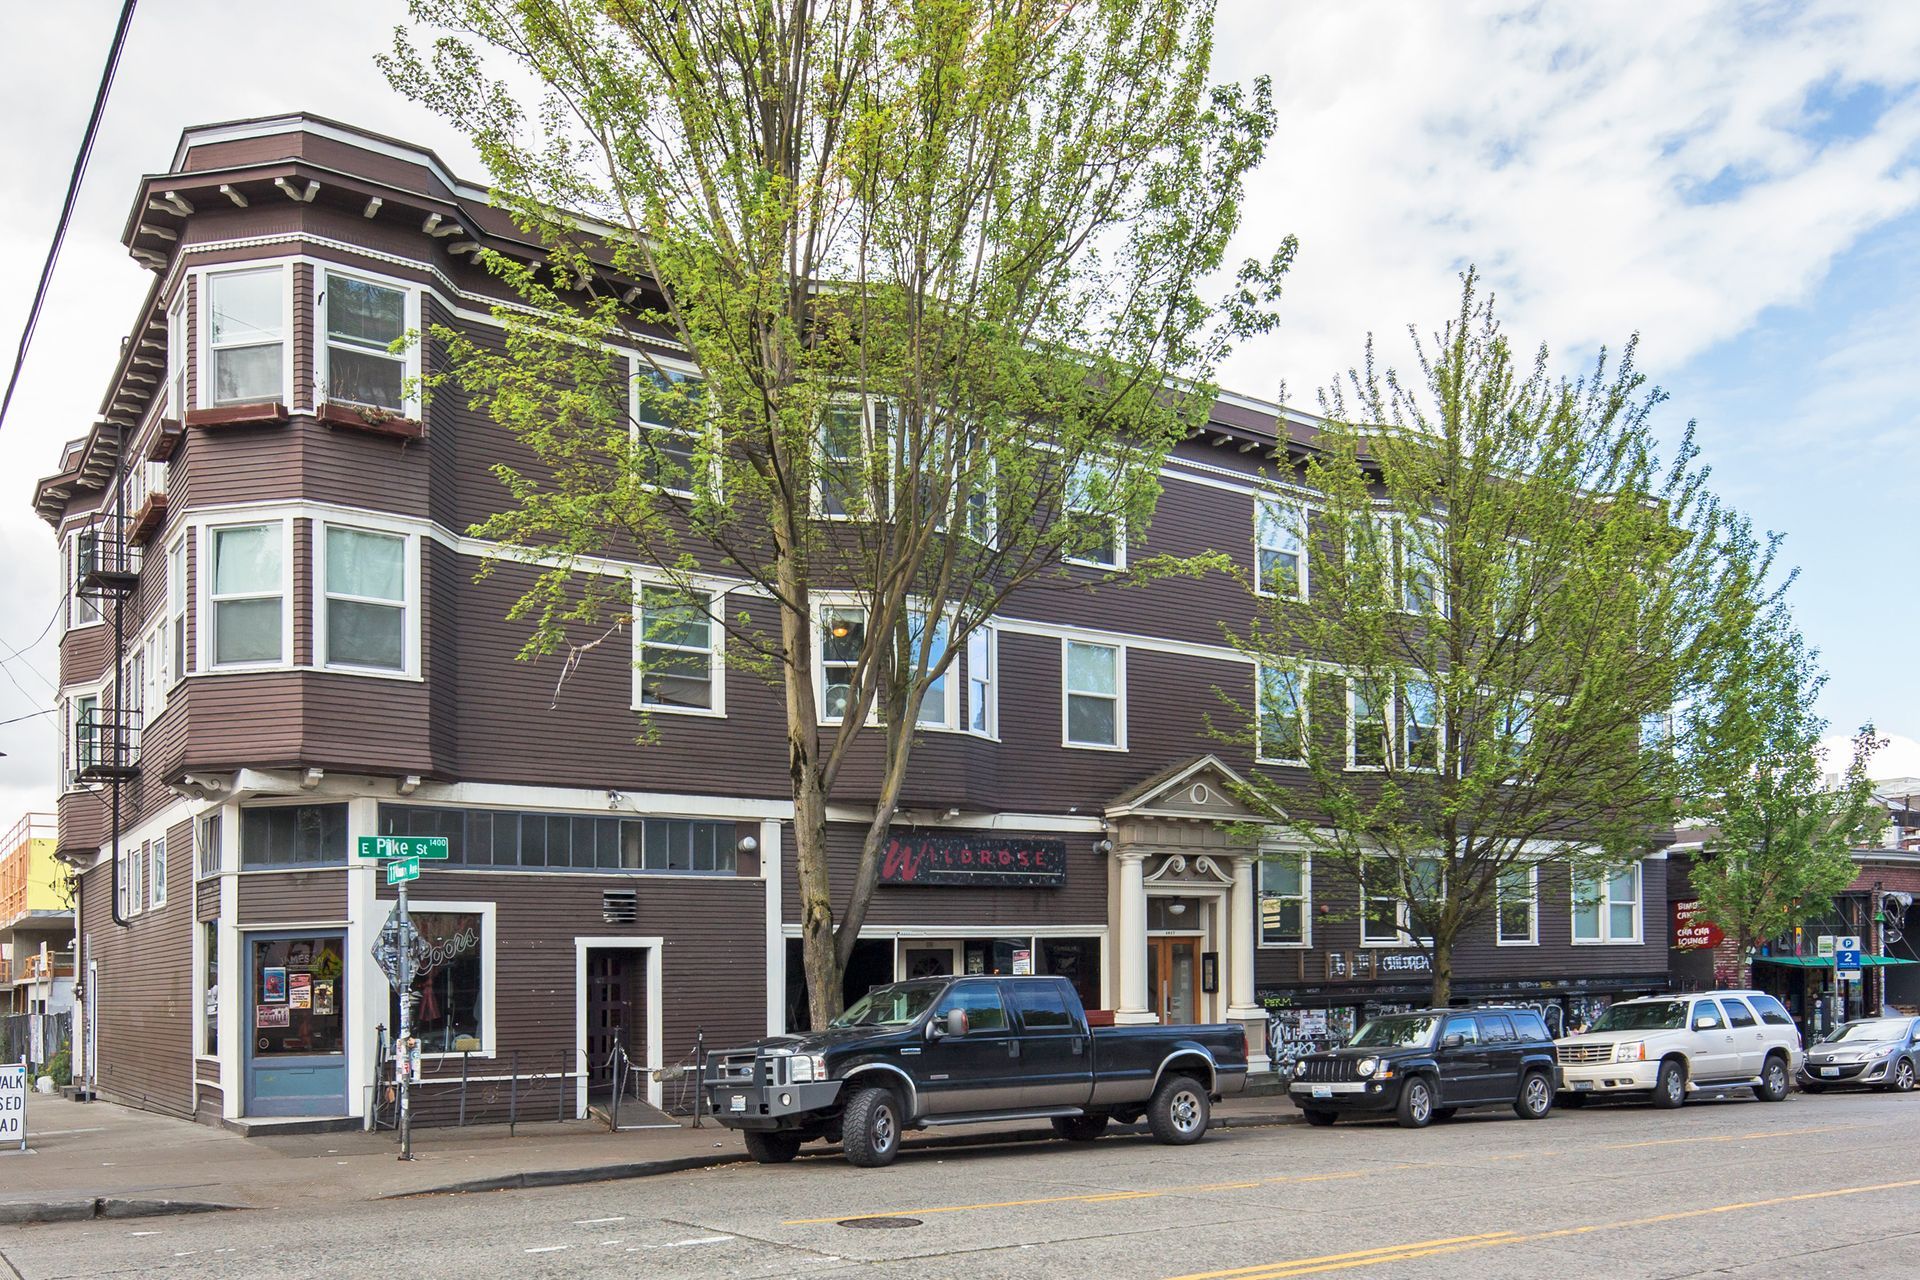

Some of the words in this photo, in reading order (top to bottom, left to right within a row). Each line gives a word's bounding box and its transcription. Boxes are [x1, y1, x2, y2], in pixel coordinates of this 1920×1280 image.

[362, 843, 370, 854] E
[377, 838, 409, 856] Pike
[416, 843, 428, 855] St
[429, 839, 446, 847] 1400
[882, 839, 1047, 881] WILDROSE
[1677, 929, 1693, 937] CHA
[1694, 927, 1710, 936] CHA
[1678, 936, 1709, 946] LOUNGE
[1844, 952, 1853, 962] 2
[0, 1075, 23, 1089] ALK
